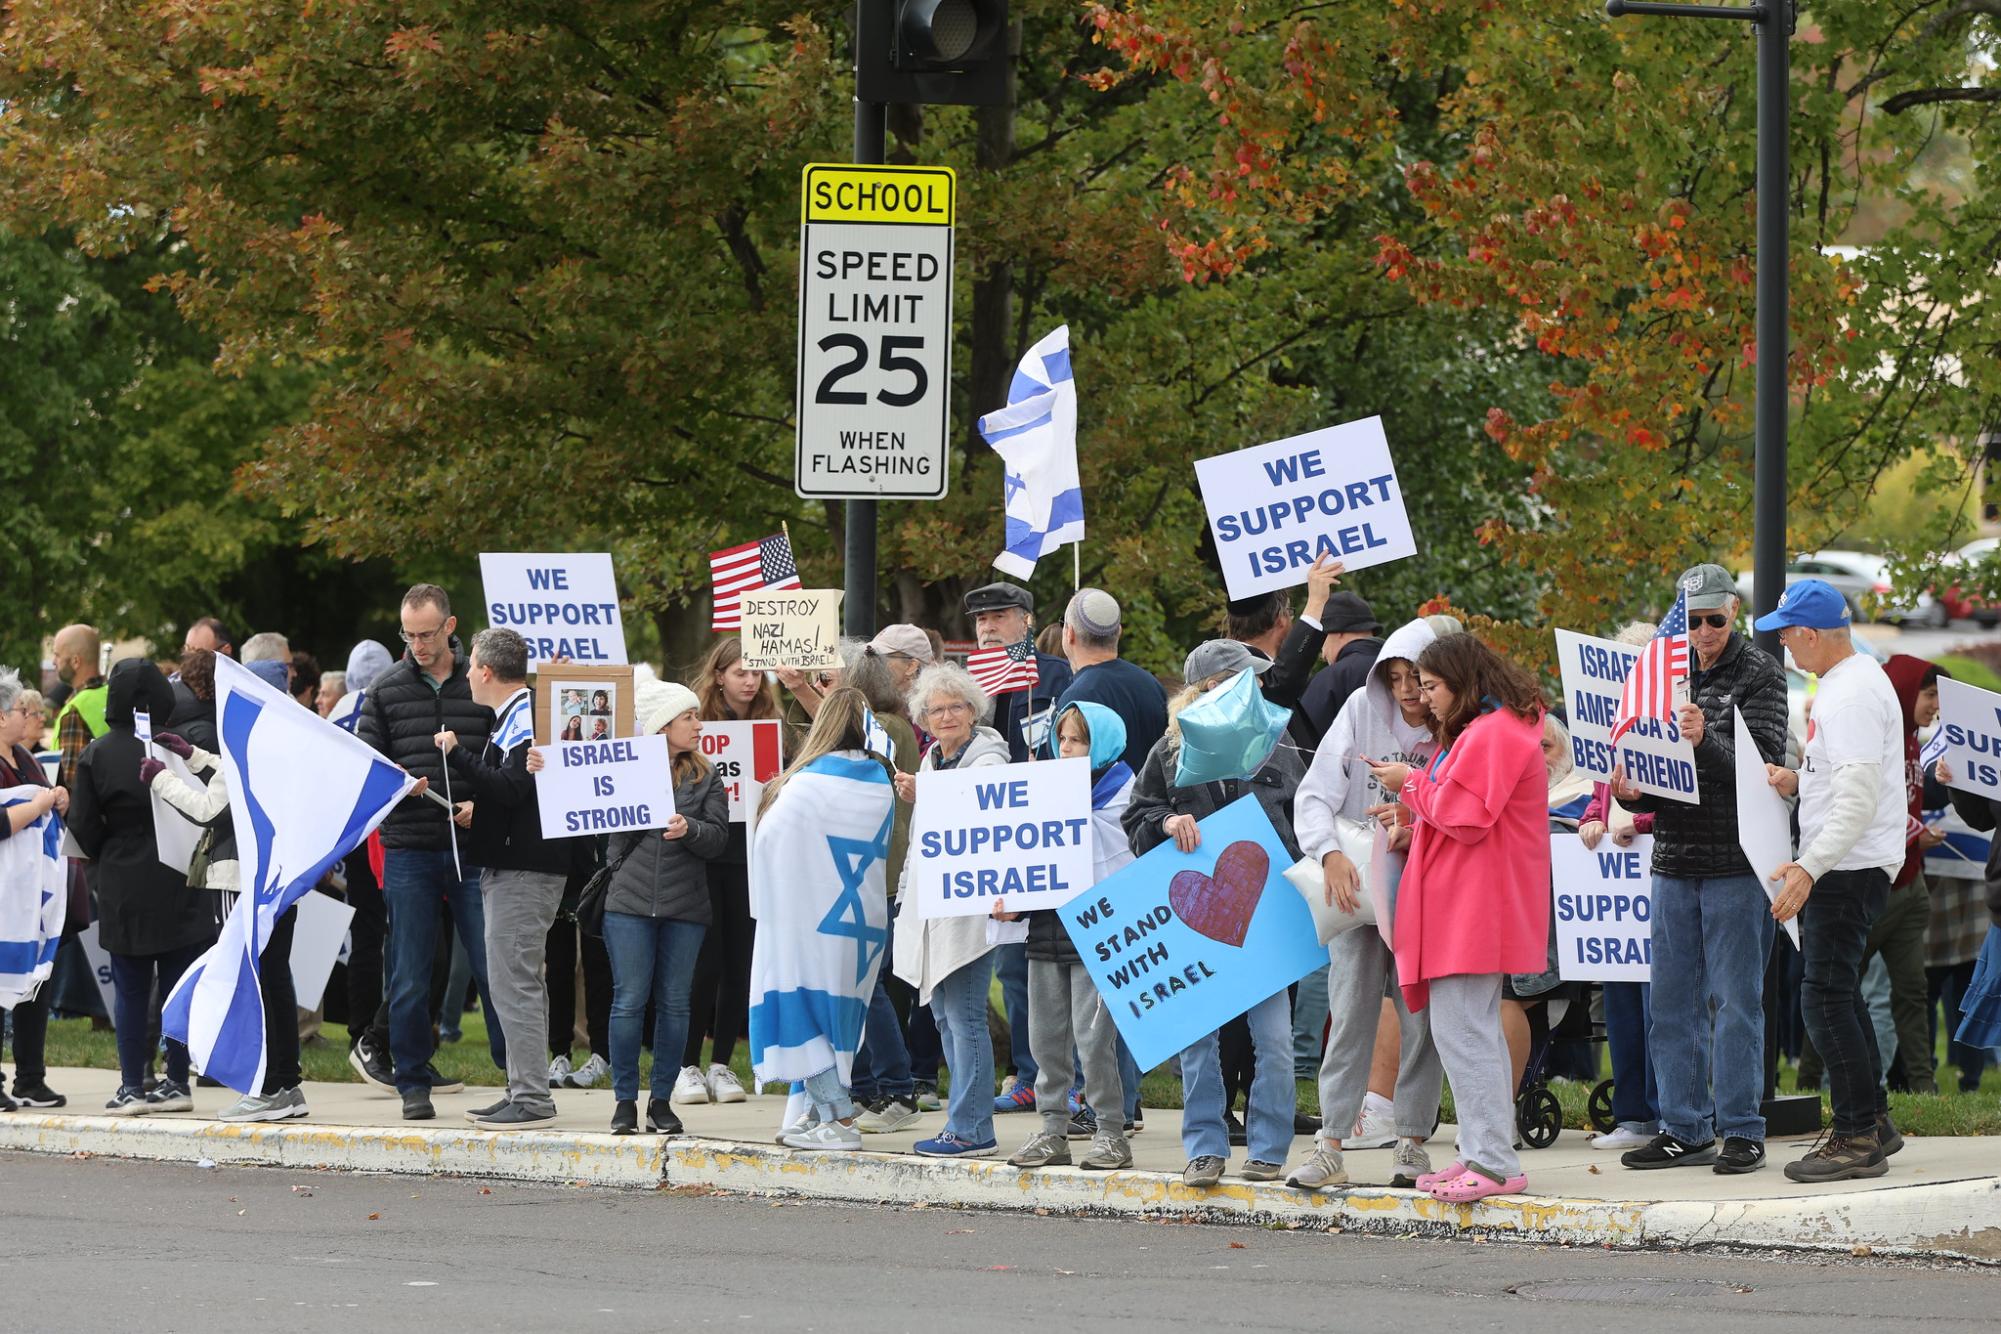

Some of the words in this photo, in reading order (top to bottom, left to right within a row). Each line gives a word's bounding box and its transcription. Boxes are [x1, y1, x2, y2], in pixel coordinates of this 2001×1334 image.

[815, 181, 944, 213] SCHOOL
[816, 250, 939, 282] SPEED
[828, 293, 924, 323] LIMIT
[815, 333, 929, 407] 25
[839, 431, 905, 450] WHEN
[812, 454, 931, 475] FLASHING
[1263, 449, 1326, 487] WE
[1216, 473, 1393, 543] SUPPORT
[1248, 522, 1388, 578] ISRAEL
[526, 568, 569, 590] WE
[490, 603, 617, 625] SUPPORT
[746, 599, 819, 616] DESTROY
[753, 622, 784, 639] NAZI
[760, 624, 821, 656] HAMAS!
[522, 637, 609, 660] SRAEL
[748, 656, 777, 668] STAND
[780, 655, 800, 667] WITH
[800, 654, 835, 667] ISRAEL
[1578, 643, 1638, 684] ISRAE
[562, 741, 639, 768] ISRAEL
[1571, 735, 1617, 775] BEST
[1623, 748, 1695, 794] FRIEND
[593, 775, 615, 797] IS
[975, 780, 1029, 811] WE
[565, 803, 652, 832] STRONG
[920, 818, 1088, 859] SUPPORT
[1597, 852, 1642, 879] WE
[942, 863, 1069, 900] ISRAEL
[1076, 896, 1115, 929] WE
[1557, 894, 1651, 922] SUPPO
[1094, 905, 1173, 962] STAND
[1106, 941, 1169, 990] WITH
[1576, 937, 1651, 965] ISRA
[1128, 960, 1217, 1019] ISRAEL
